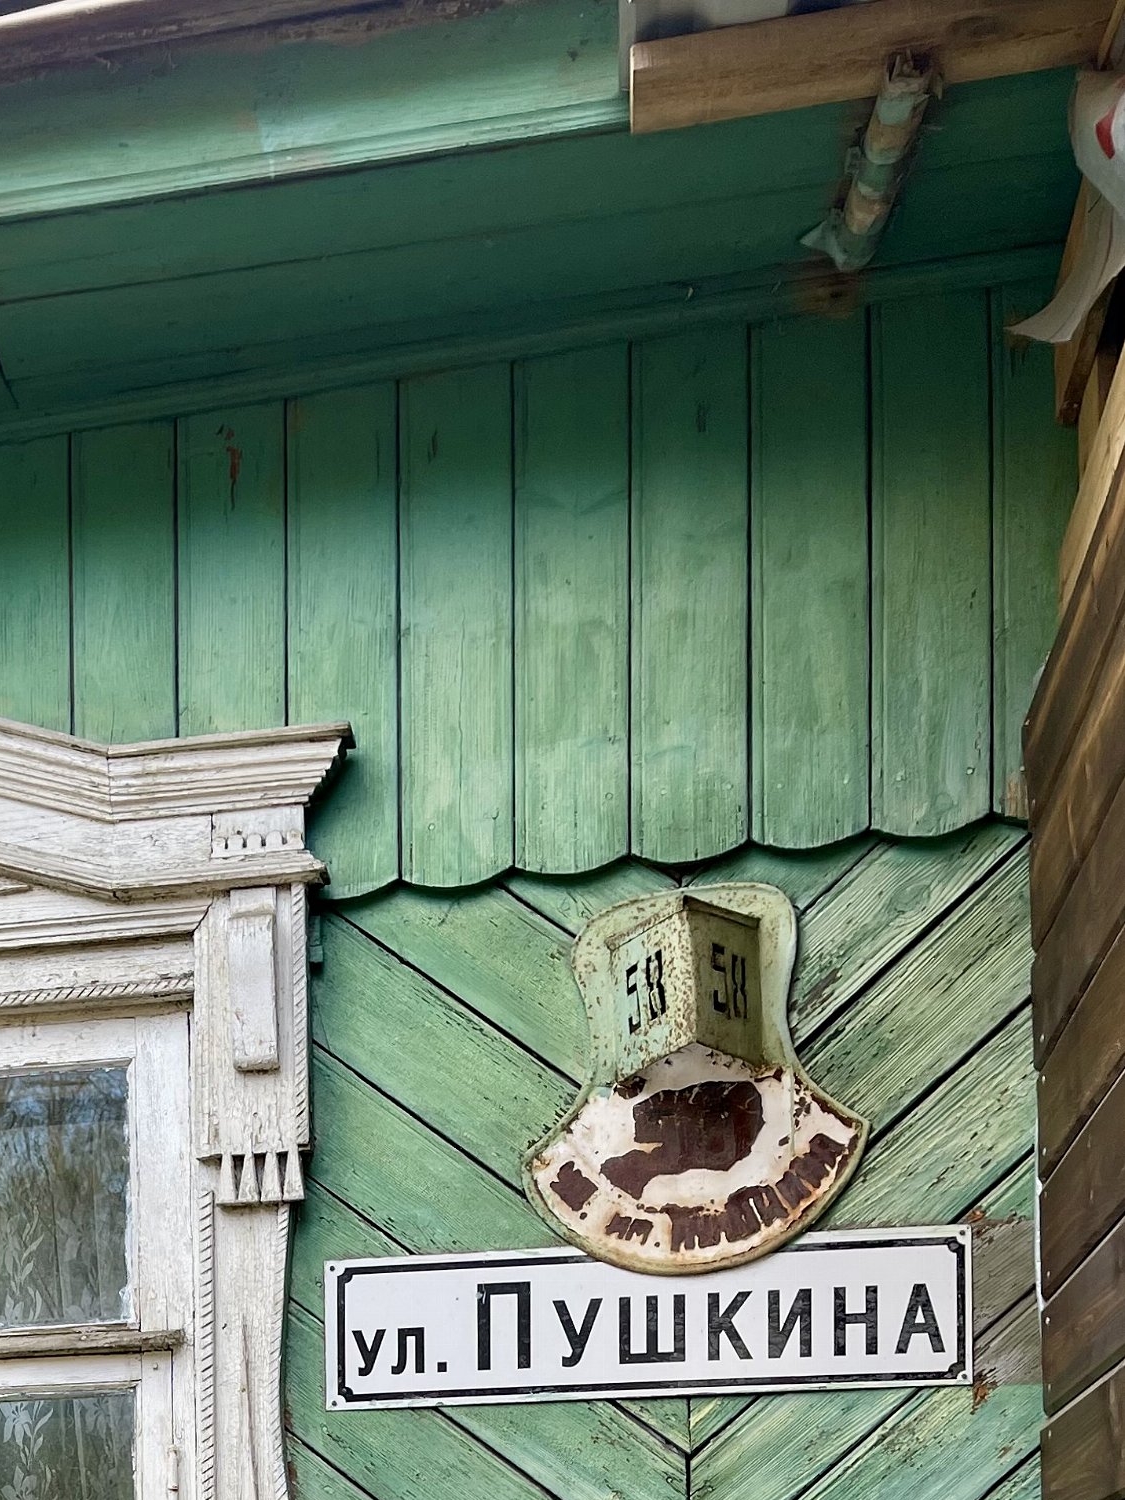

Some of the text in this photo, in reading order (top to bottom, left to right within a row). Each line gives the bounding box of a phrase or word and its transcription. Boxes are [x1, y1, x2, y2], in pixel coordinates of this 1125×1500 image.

[626, 949, 666, 1035] 58
[711, 943, 748, 1020] 58
[352, 1281, 946, 1377] ул. ПУШКИНА
